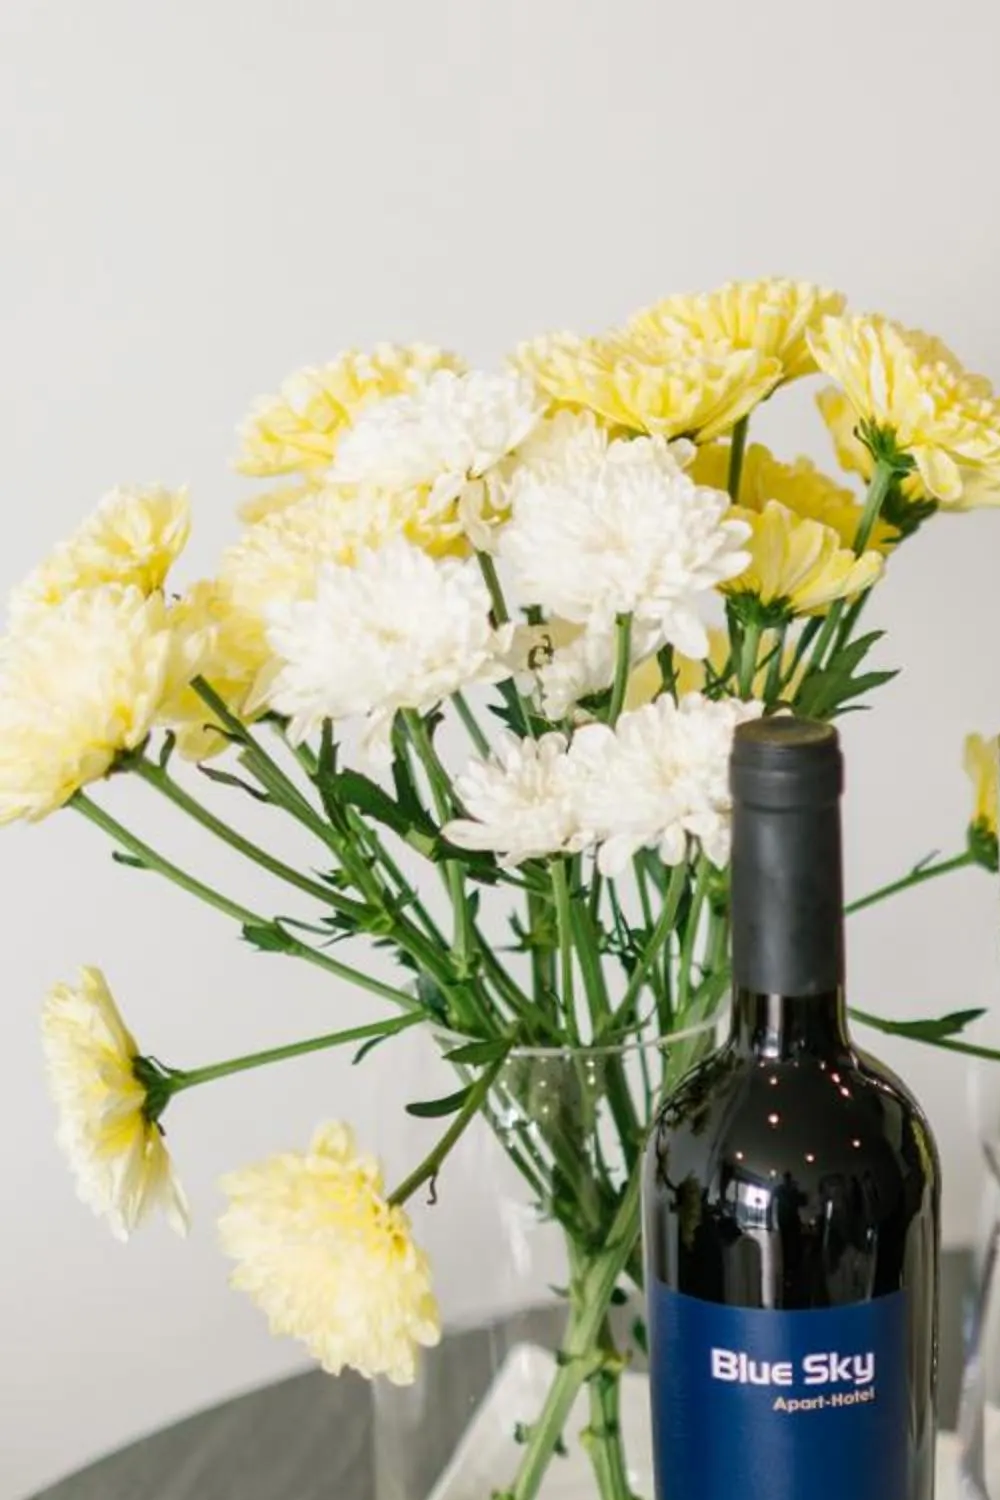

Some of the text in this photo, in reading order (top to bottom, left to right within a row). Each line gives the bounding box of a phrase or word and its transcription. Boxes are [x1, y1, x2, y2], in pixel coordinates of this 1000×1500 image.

[710, 1347, 875, 1385] Blue Sky
[772, 1387, 875, 1413] Apart-Hotel
